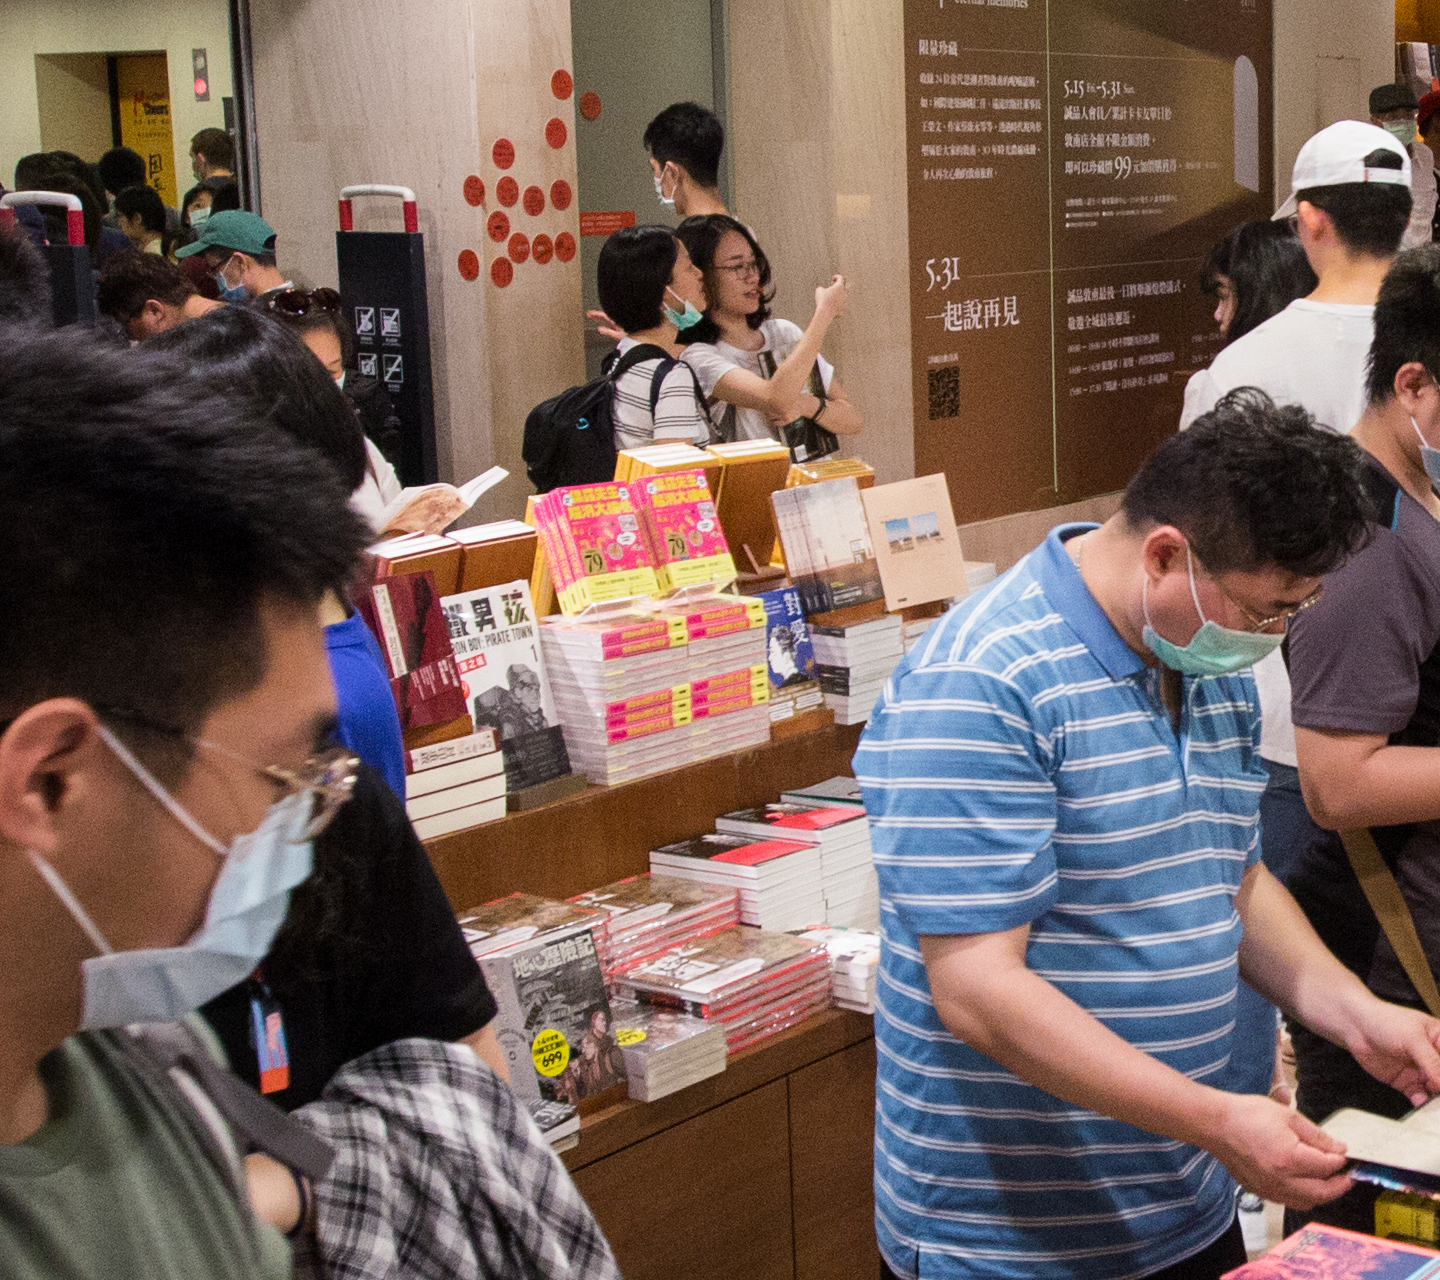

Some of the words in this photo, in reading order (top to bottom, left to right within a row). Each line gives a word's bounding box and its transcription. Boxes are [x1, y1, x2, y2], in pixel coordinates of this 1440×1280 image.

[1063, 80, 1085, 99] 5.15
[1114, 156, 1132, 180] 99
[925, 257, 961, 292] 5.31
[925, 295, 1021, 332] 一起說再見
[668, 537, 686, 557] 79
[584, 553, 603, 573] 79
[485, 631, 510, 649] PIRATE
[510, 624, 534, 642] TOWN
[530, 643, 539, 663] 1
[513, 933, 595, 979] 地心歷險記
[542, 1050, 563, 1068] 699
